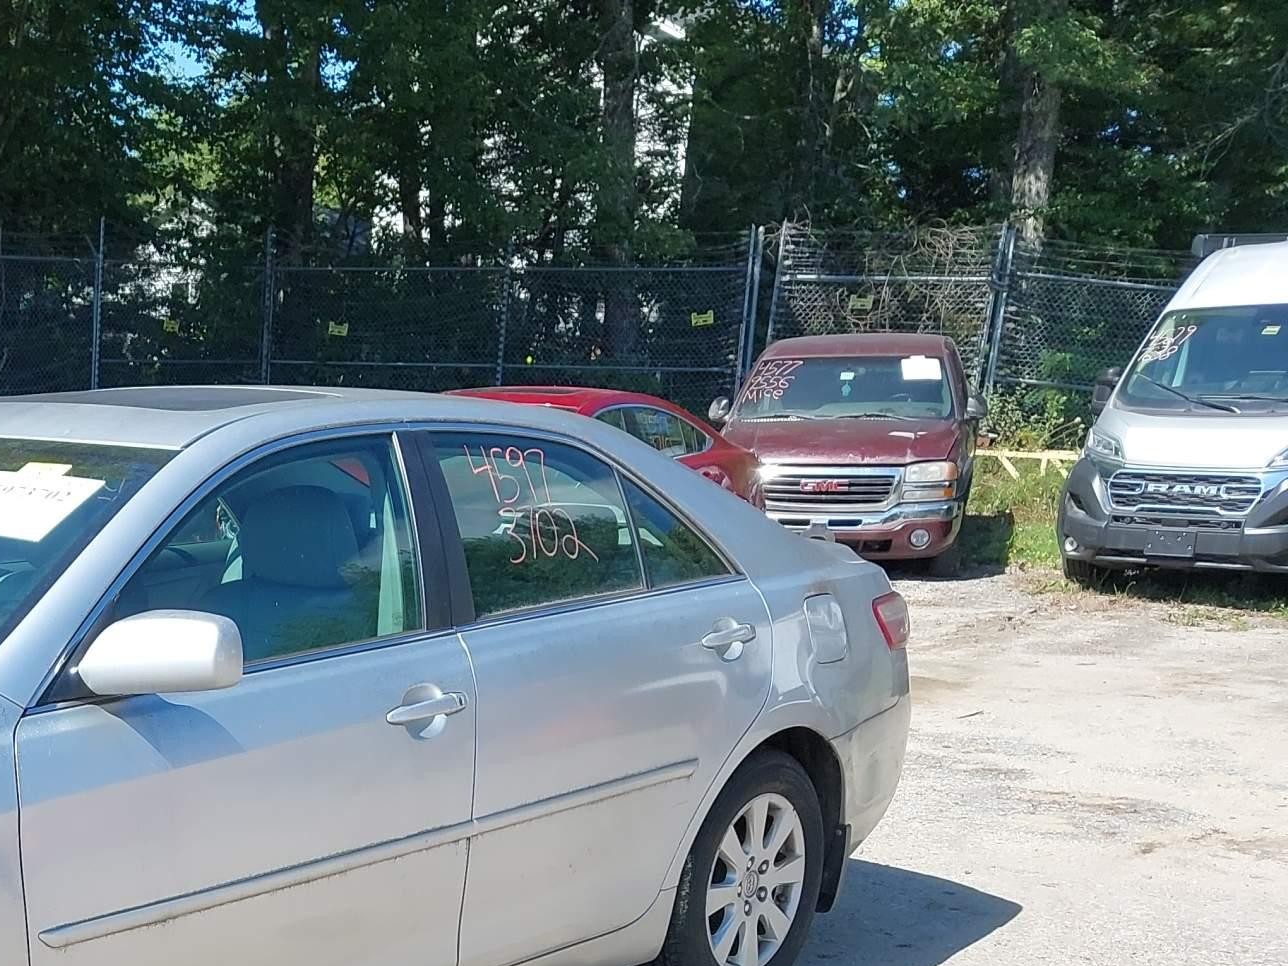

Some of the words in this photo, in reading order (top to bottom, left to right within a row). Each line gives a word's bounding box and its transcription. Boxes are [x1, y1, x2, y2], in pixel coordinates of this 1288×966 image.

[758, 360, 804, 376] 4577
[463, 444, 551, 505] 4597
[799, 479, 849, 492] GMC
[1147, 482, 1218, 495] RAM
[497, 504, 600, 564] 3702
